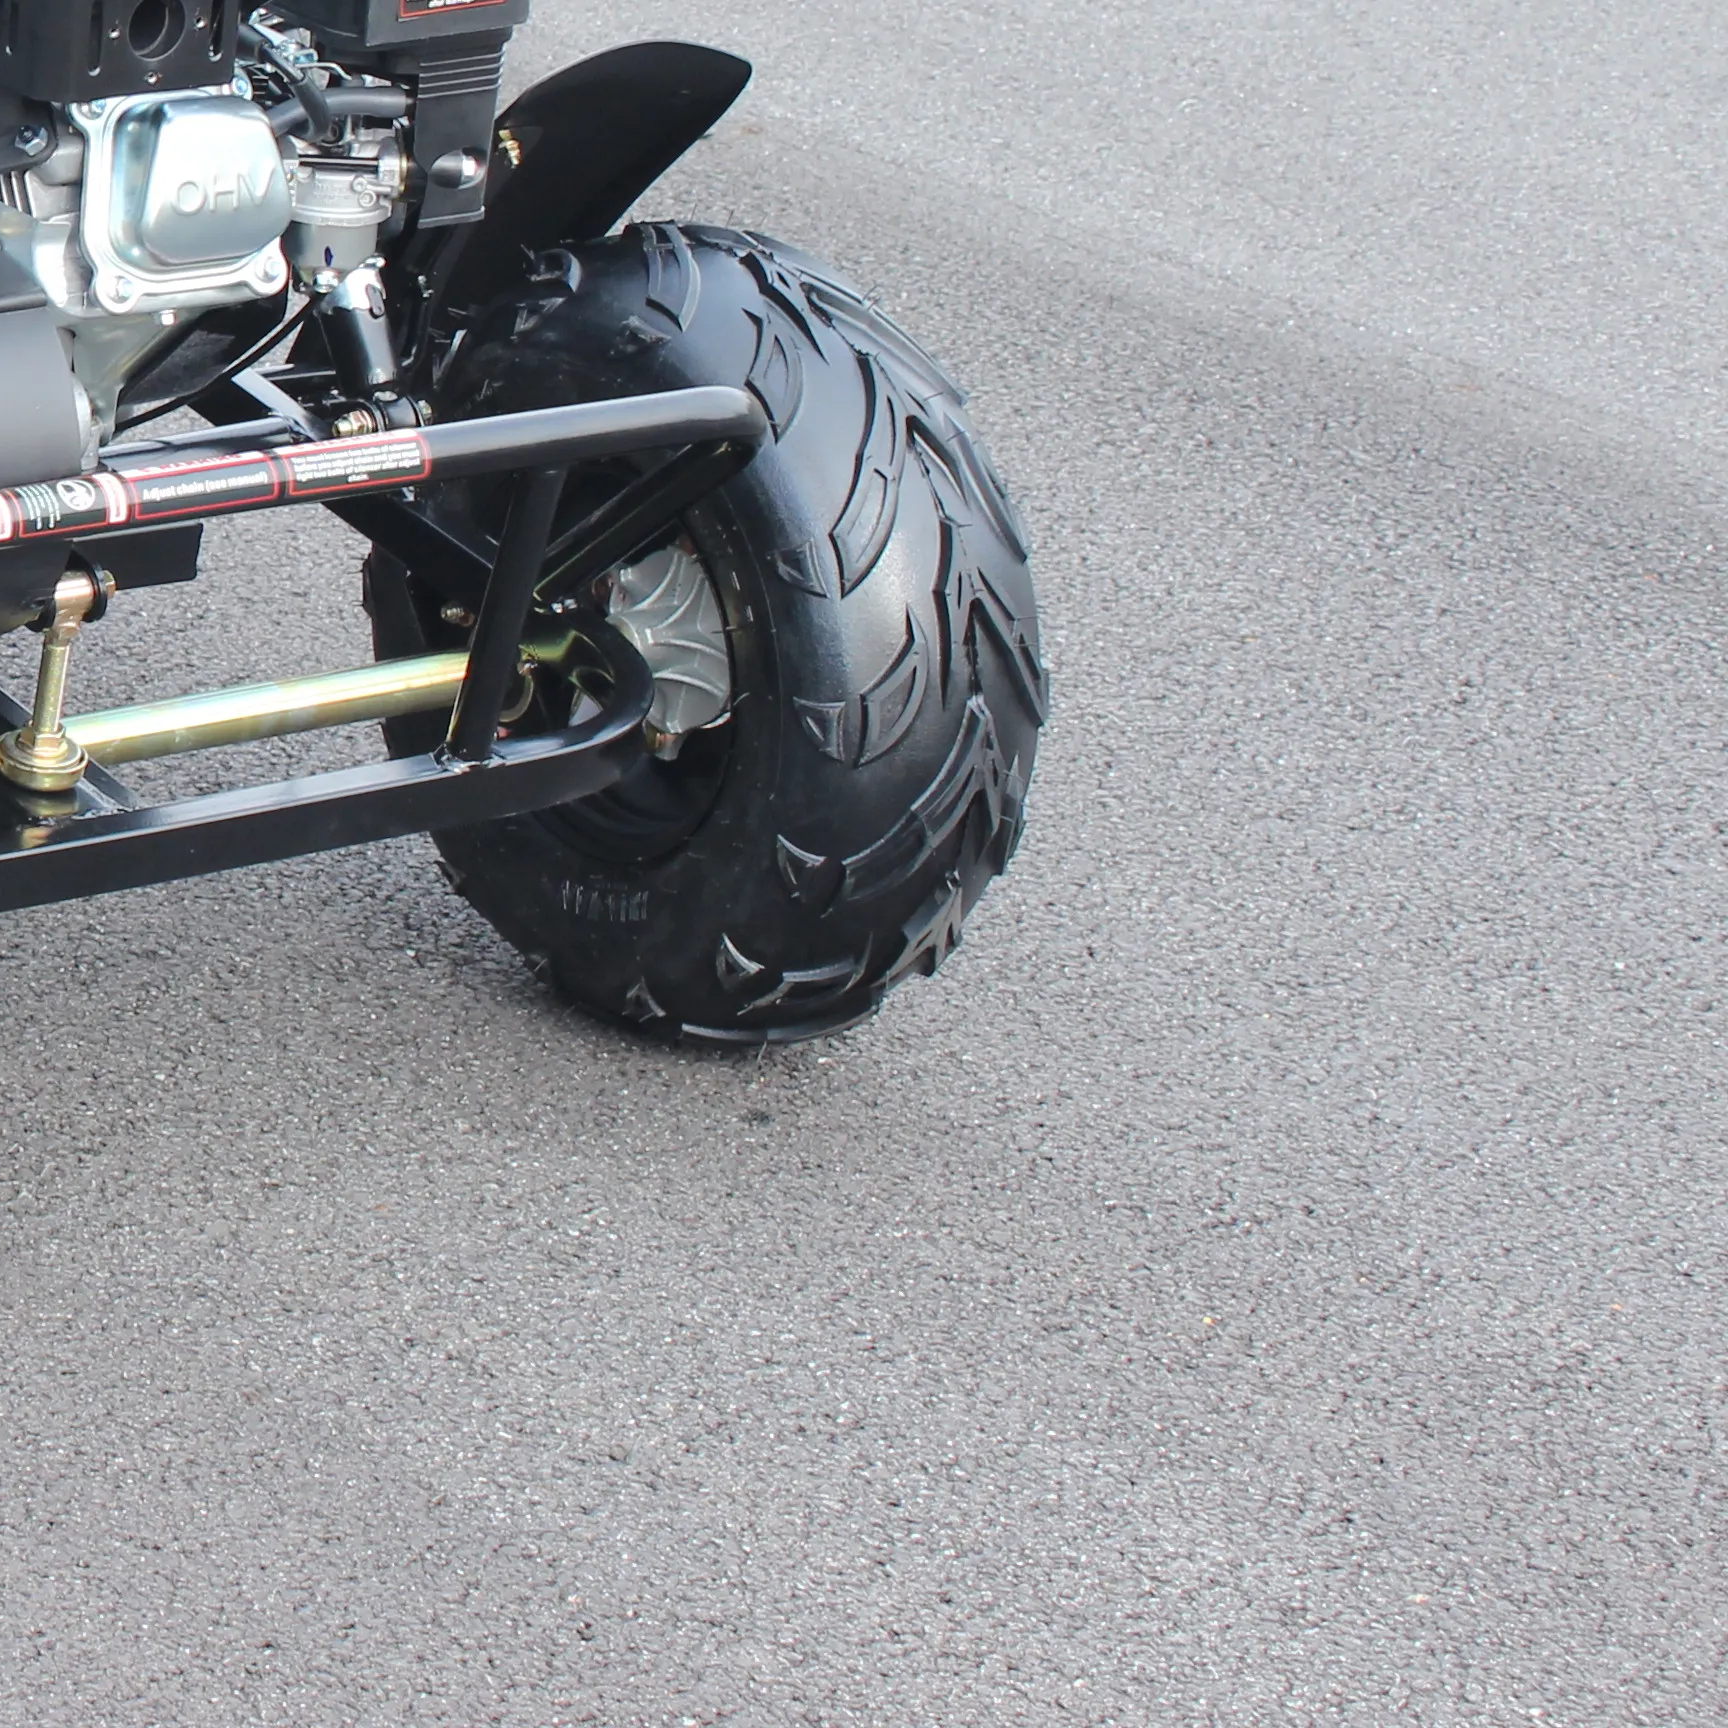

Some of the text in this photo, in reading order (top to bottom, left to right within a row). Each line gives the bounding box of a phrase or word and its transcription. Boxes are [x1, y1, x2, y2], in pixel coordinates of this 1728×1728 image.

[170, 164, 276, 217] OHV
[142, 471, 268, 502] Adjust chain (see manual)
